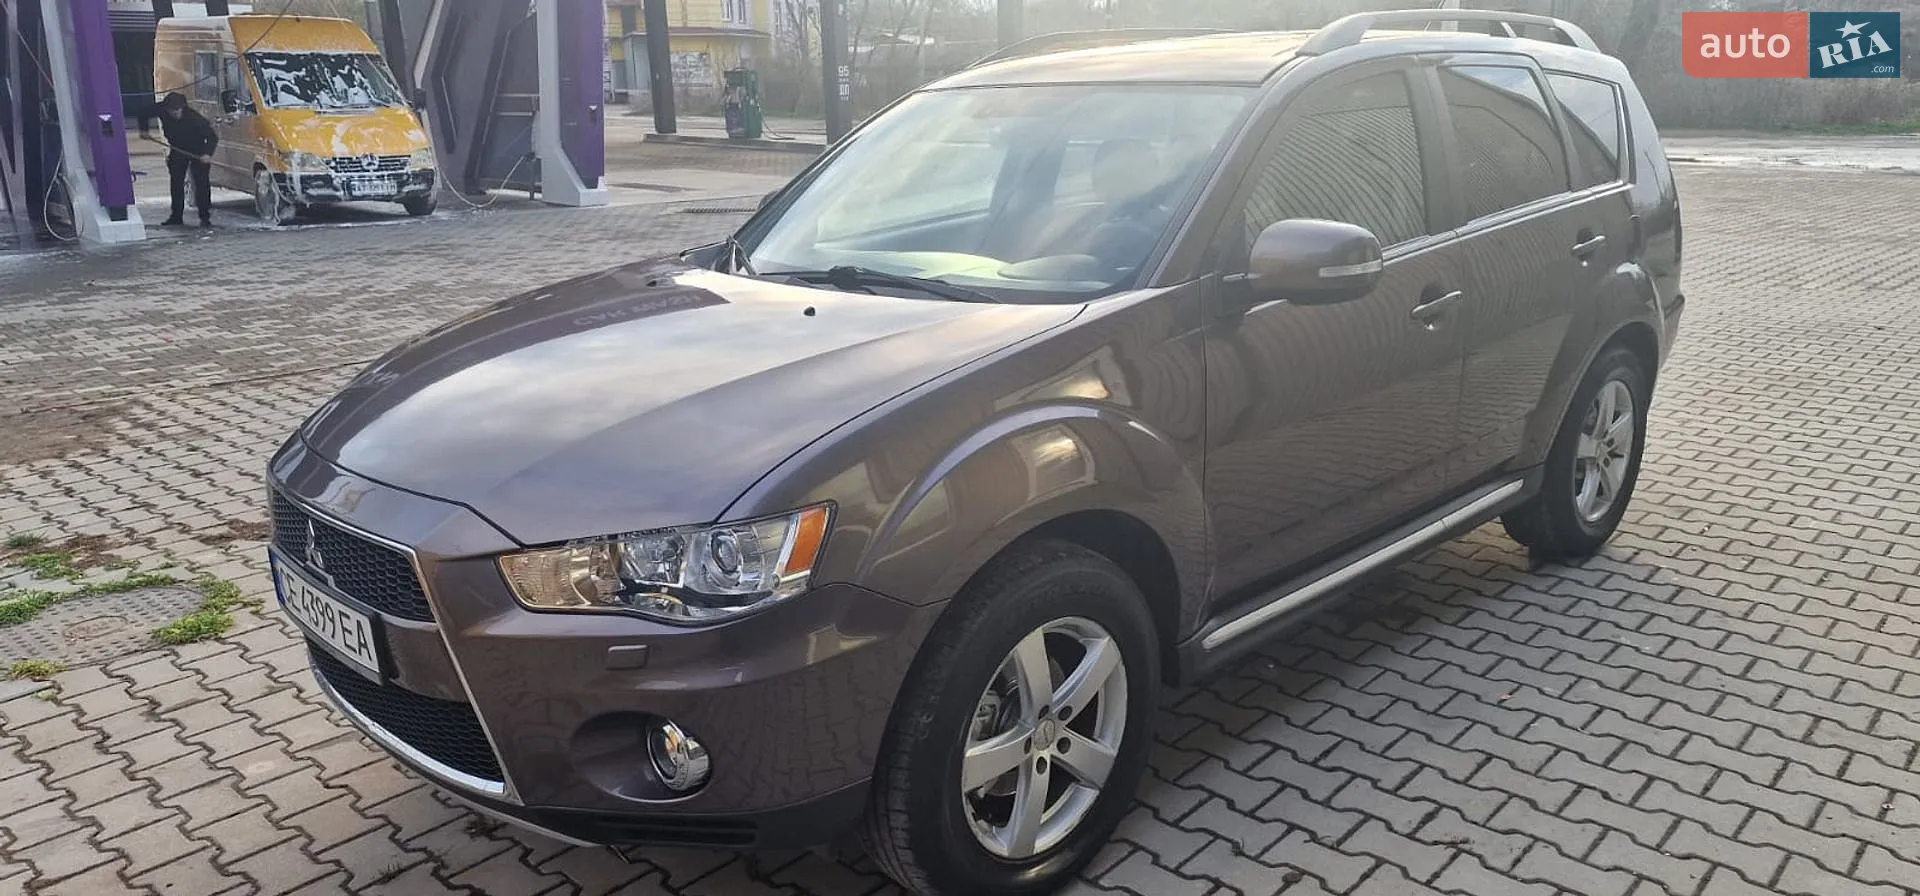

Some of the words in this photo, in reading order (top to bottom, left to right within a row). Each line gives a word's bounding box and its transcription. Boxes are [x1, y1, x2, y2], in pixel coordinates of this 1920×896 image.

[838, 65, 849, 77] 95
[279, 567, 302, 613] CE
[301, 585, 336, 640] 4399
[338, 609, 373, 662] EA
